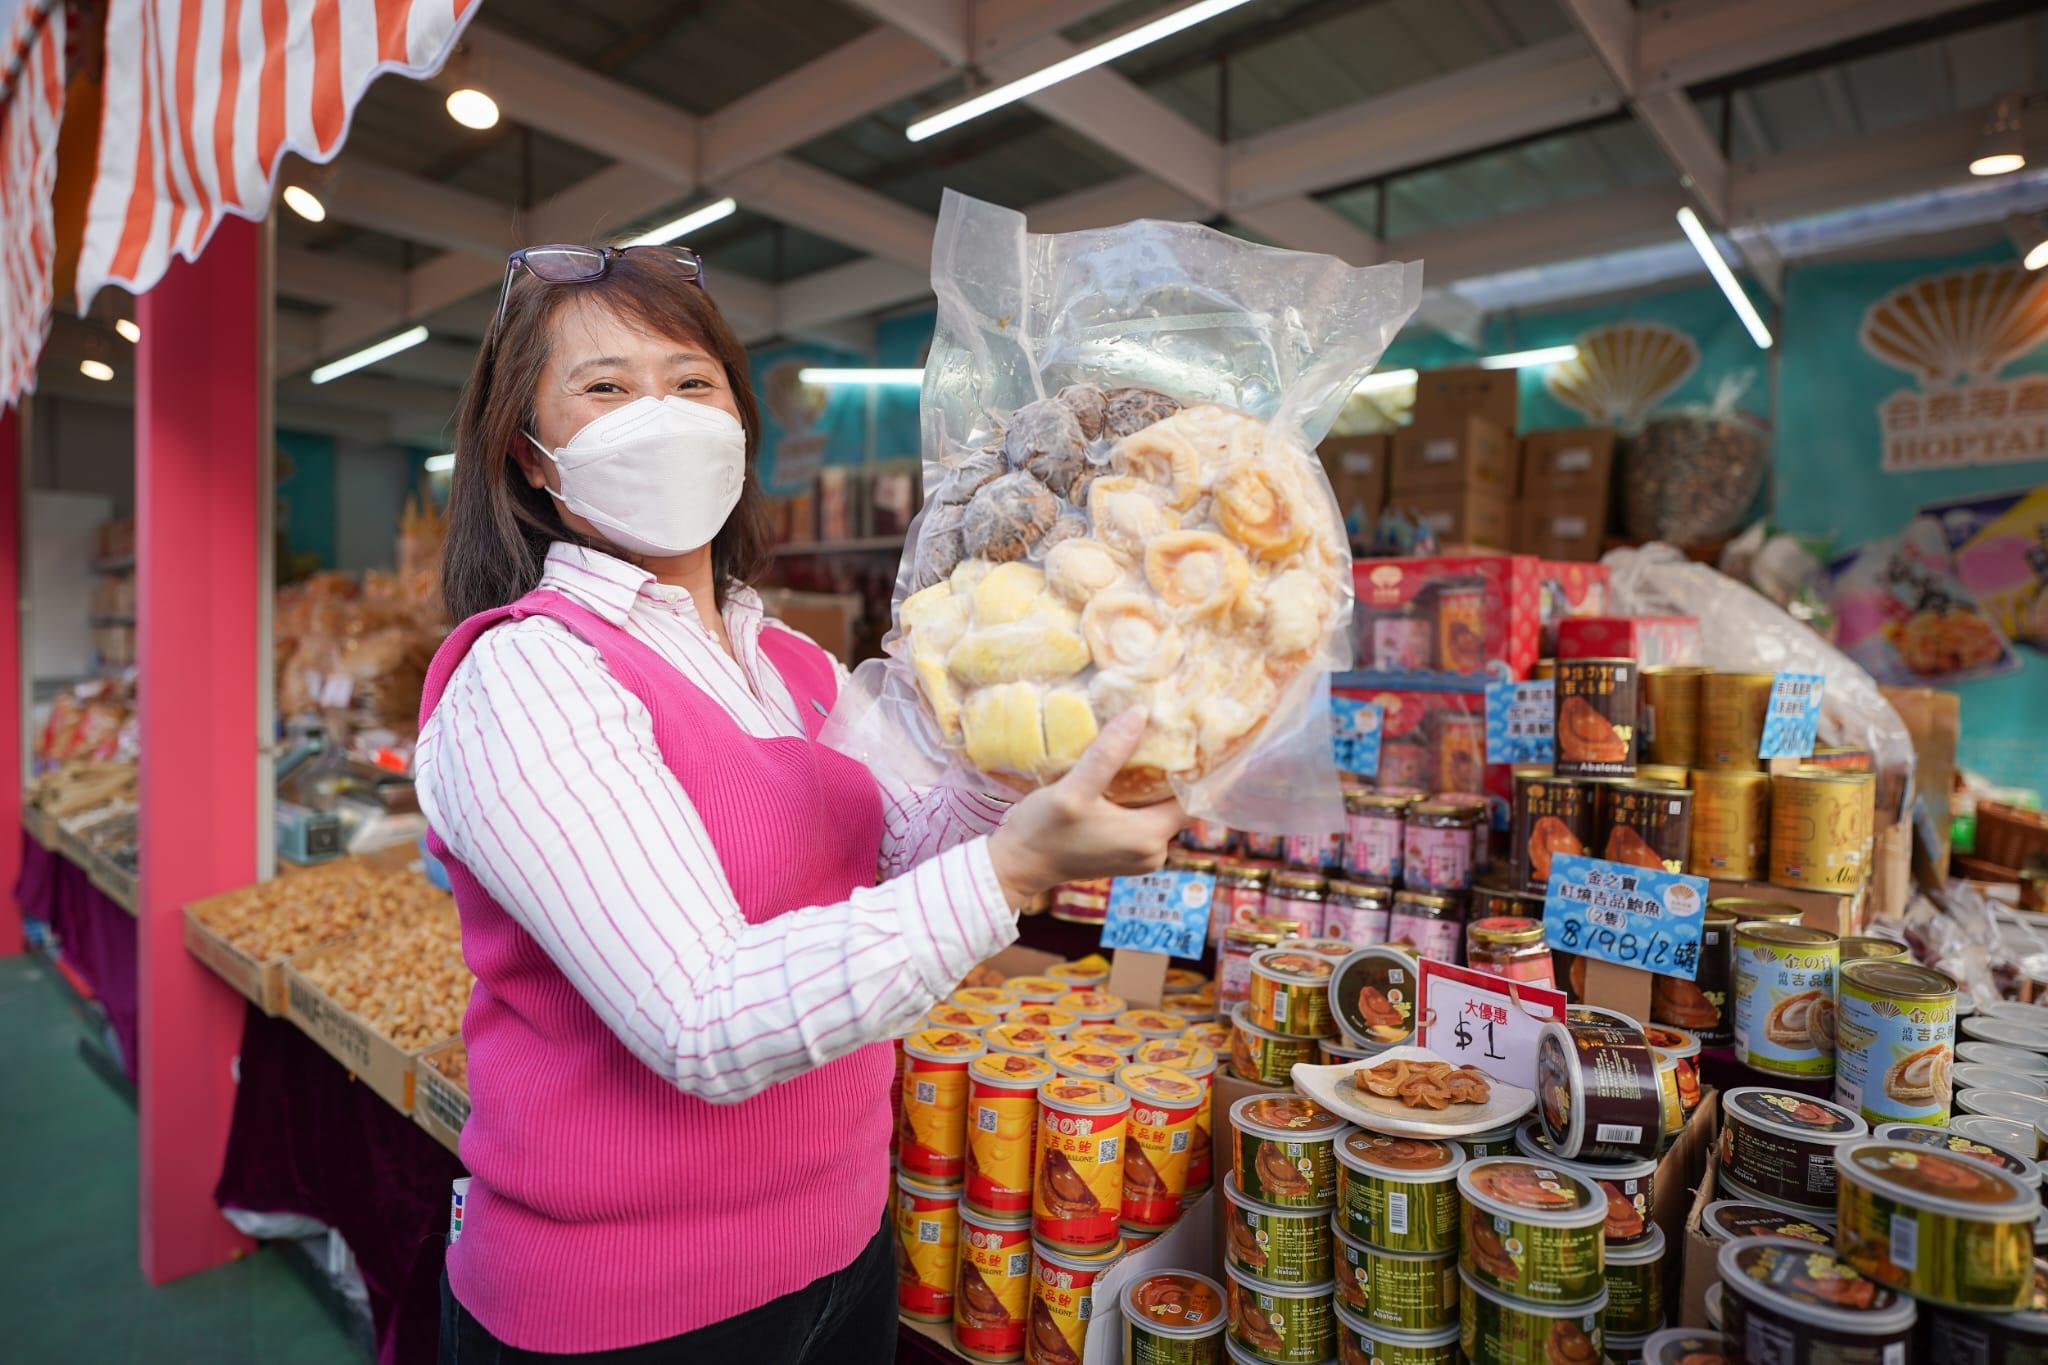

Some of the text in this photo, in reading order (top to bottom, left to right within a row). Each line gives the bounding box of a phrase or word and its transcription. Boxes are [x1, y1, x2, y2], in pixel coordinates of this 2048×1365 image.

[1587, 870, 1637, 892] 金之寶
[1560, 884, 1660, 918] 紅燒吉品鮑魚
[1465, 999, 1508, 1025] 大優惠
[1454, 1010, 1506, 1060] $1
